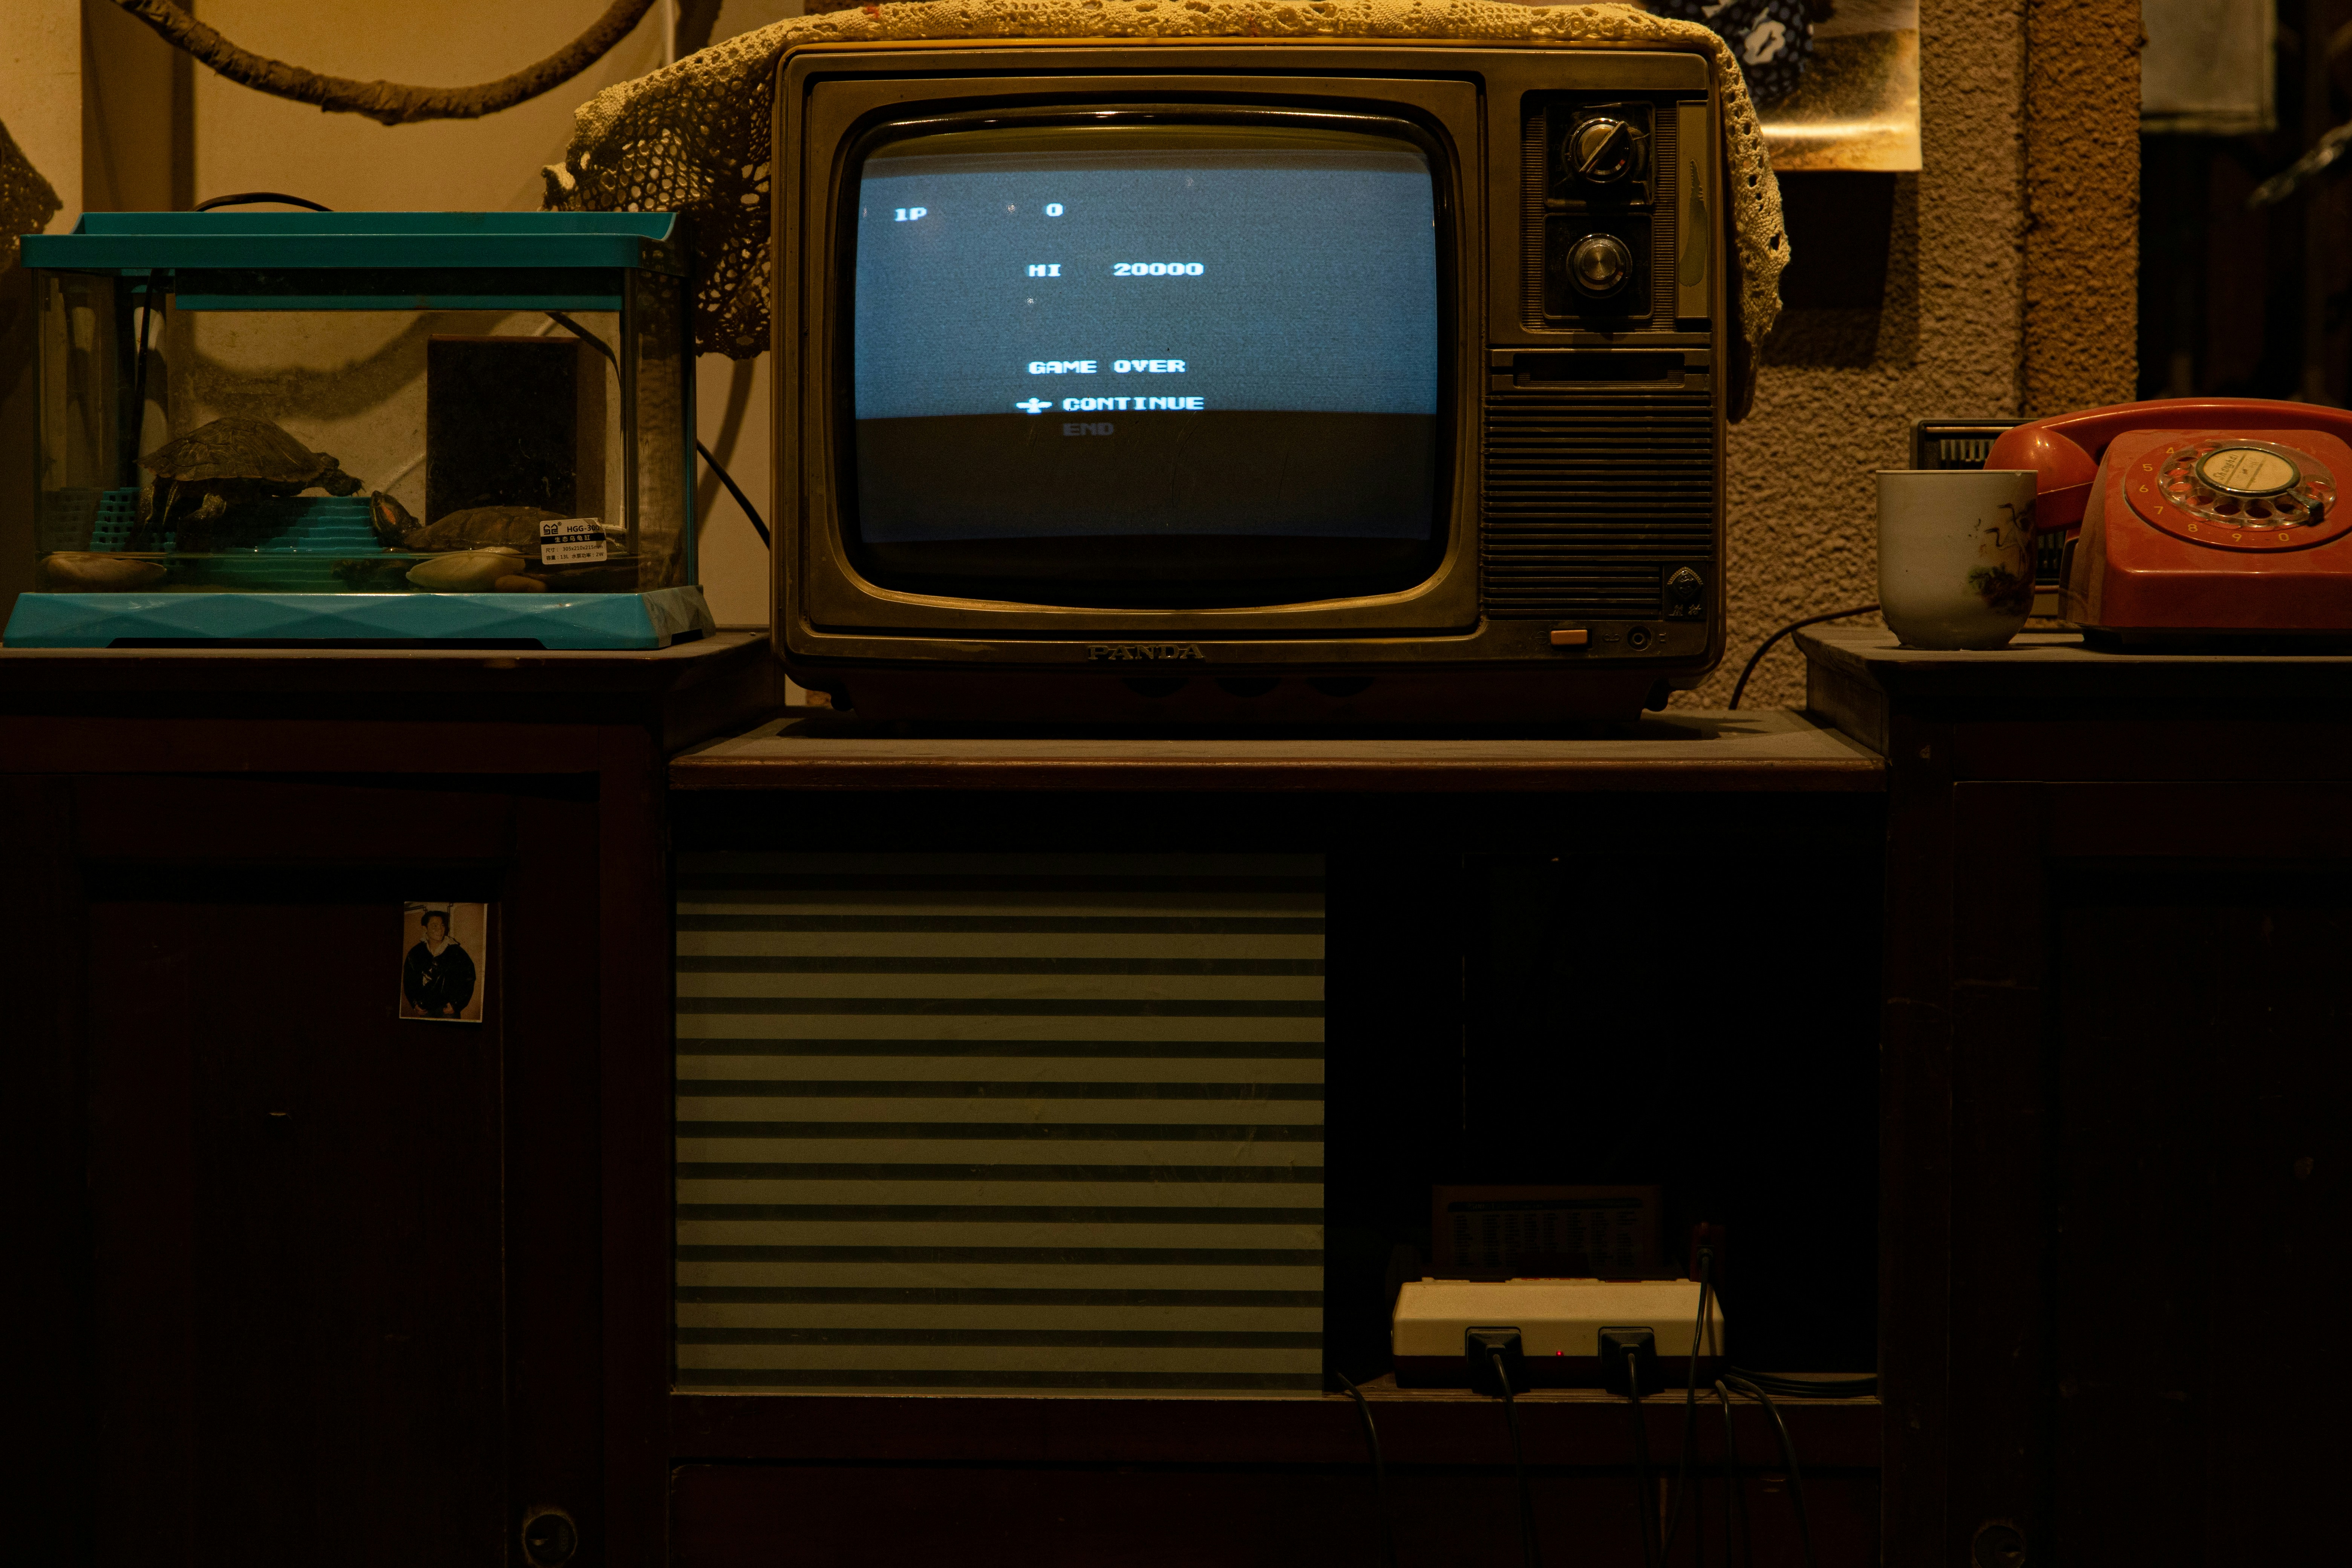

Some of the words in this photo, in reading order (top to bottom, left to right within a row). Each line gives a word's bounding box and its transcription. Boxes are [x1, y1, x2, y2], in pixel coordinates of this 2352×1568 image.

[895, 207, 927, 222] 1P
[1028, 264, 1061, 277] HI
[1113, 262, 1204, 276] 20000
[1028, 360, 1097, 375] GAME
[1113, 360, 1185, 373] OVER
[1063, 397, 1204, 411] CONTINUE
[1062, 423, 1115, 436] END
[2154, 506, 2164, 514] 7
[2232, 533, 2242, 542] 9
[1088, 644, 1205, 660] PANDA
